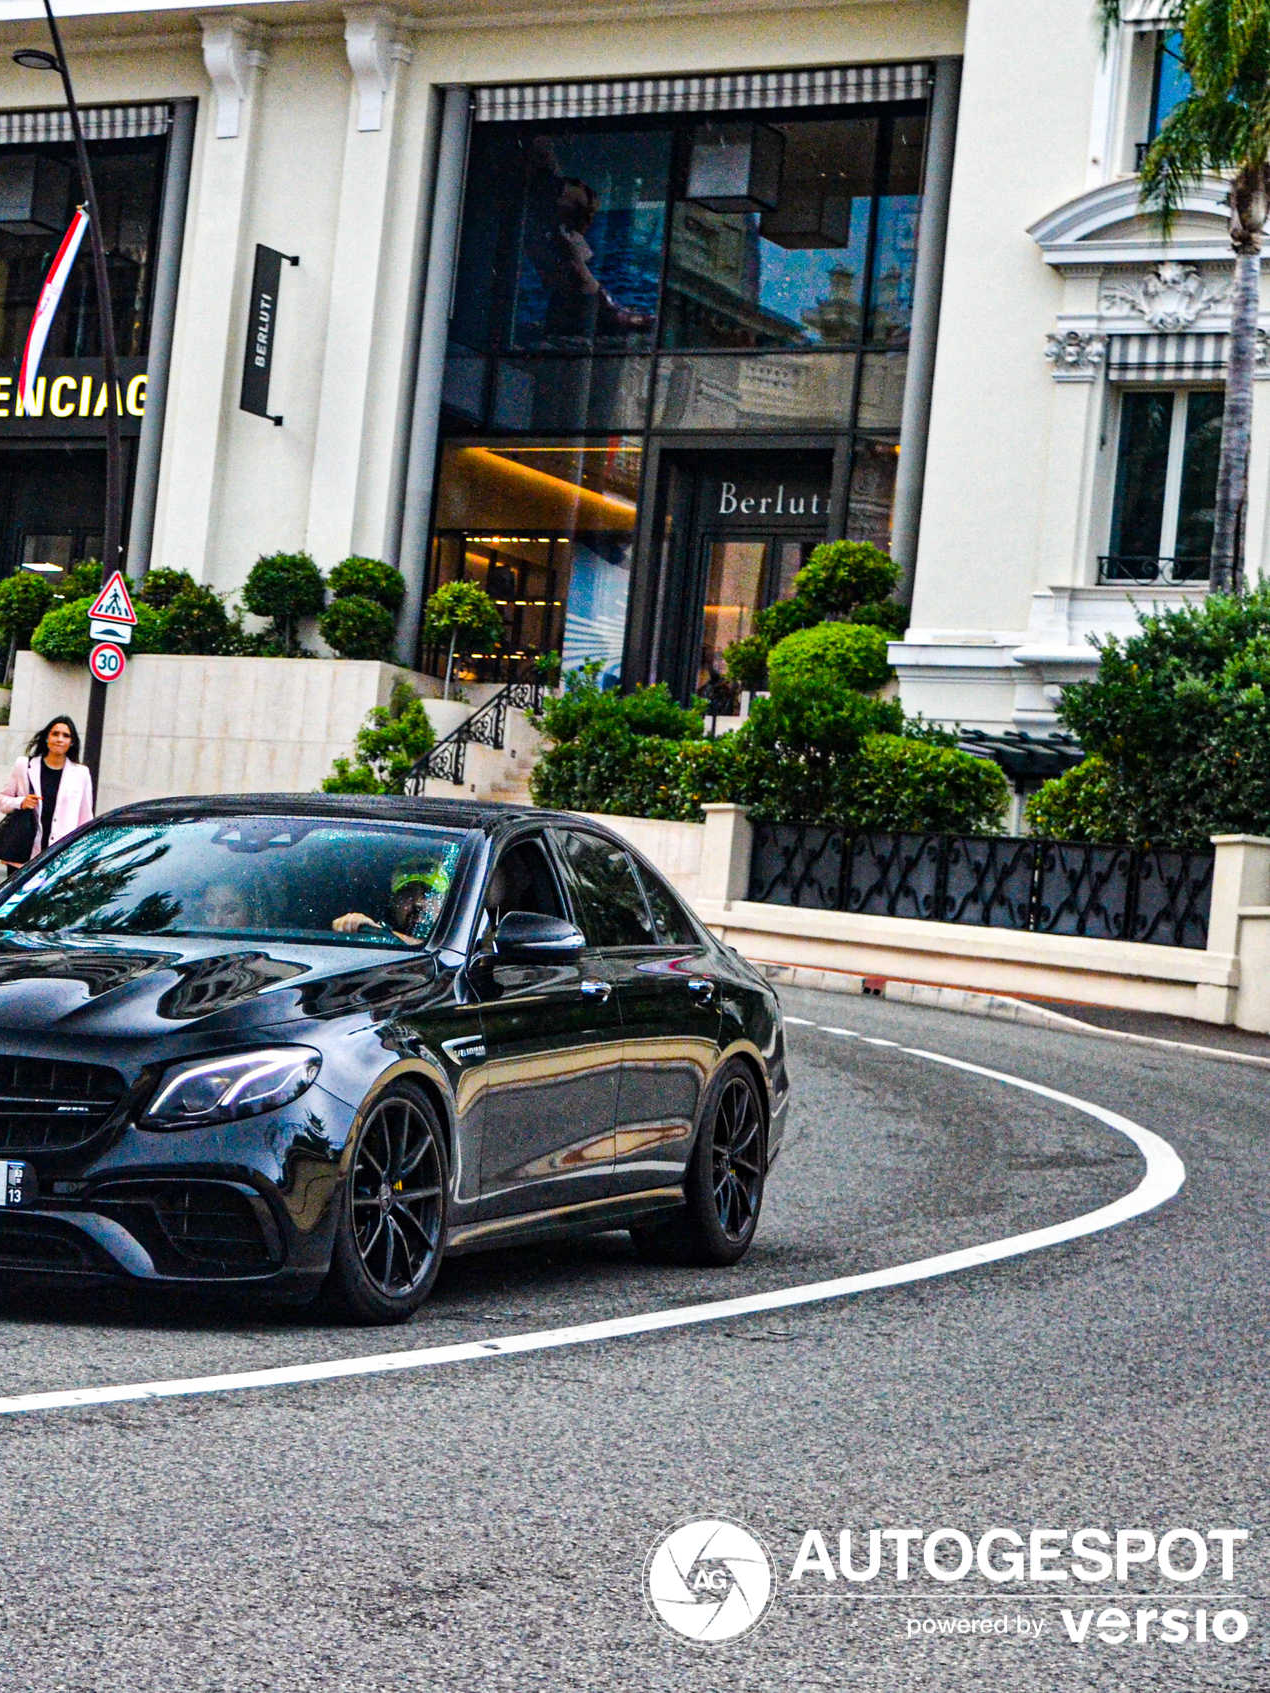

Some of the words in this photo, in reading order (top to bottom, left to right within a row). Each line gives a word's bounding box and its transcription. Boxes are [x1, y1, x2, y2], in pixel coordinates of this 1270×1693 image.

[254, 293, 273, 368] BERLUTI
[97, 653, 119, 671] 30
[8, 1189, 22, 1203] 13
